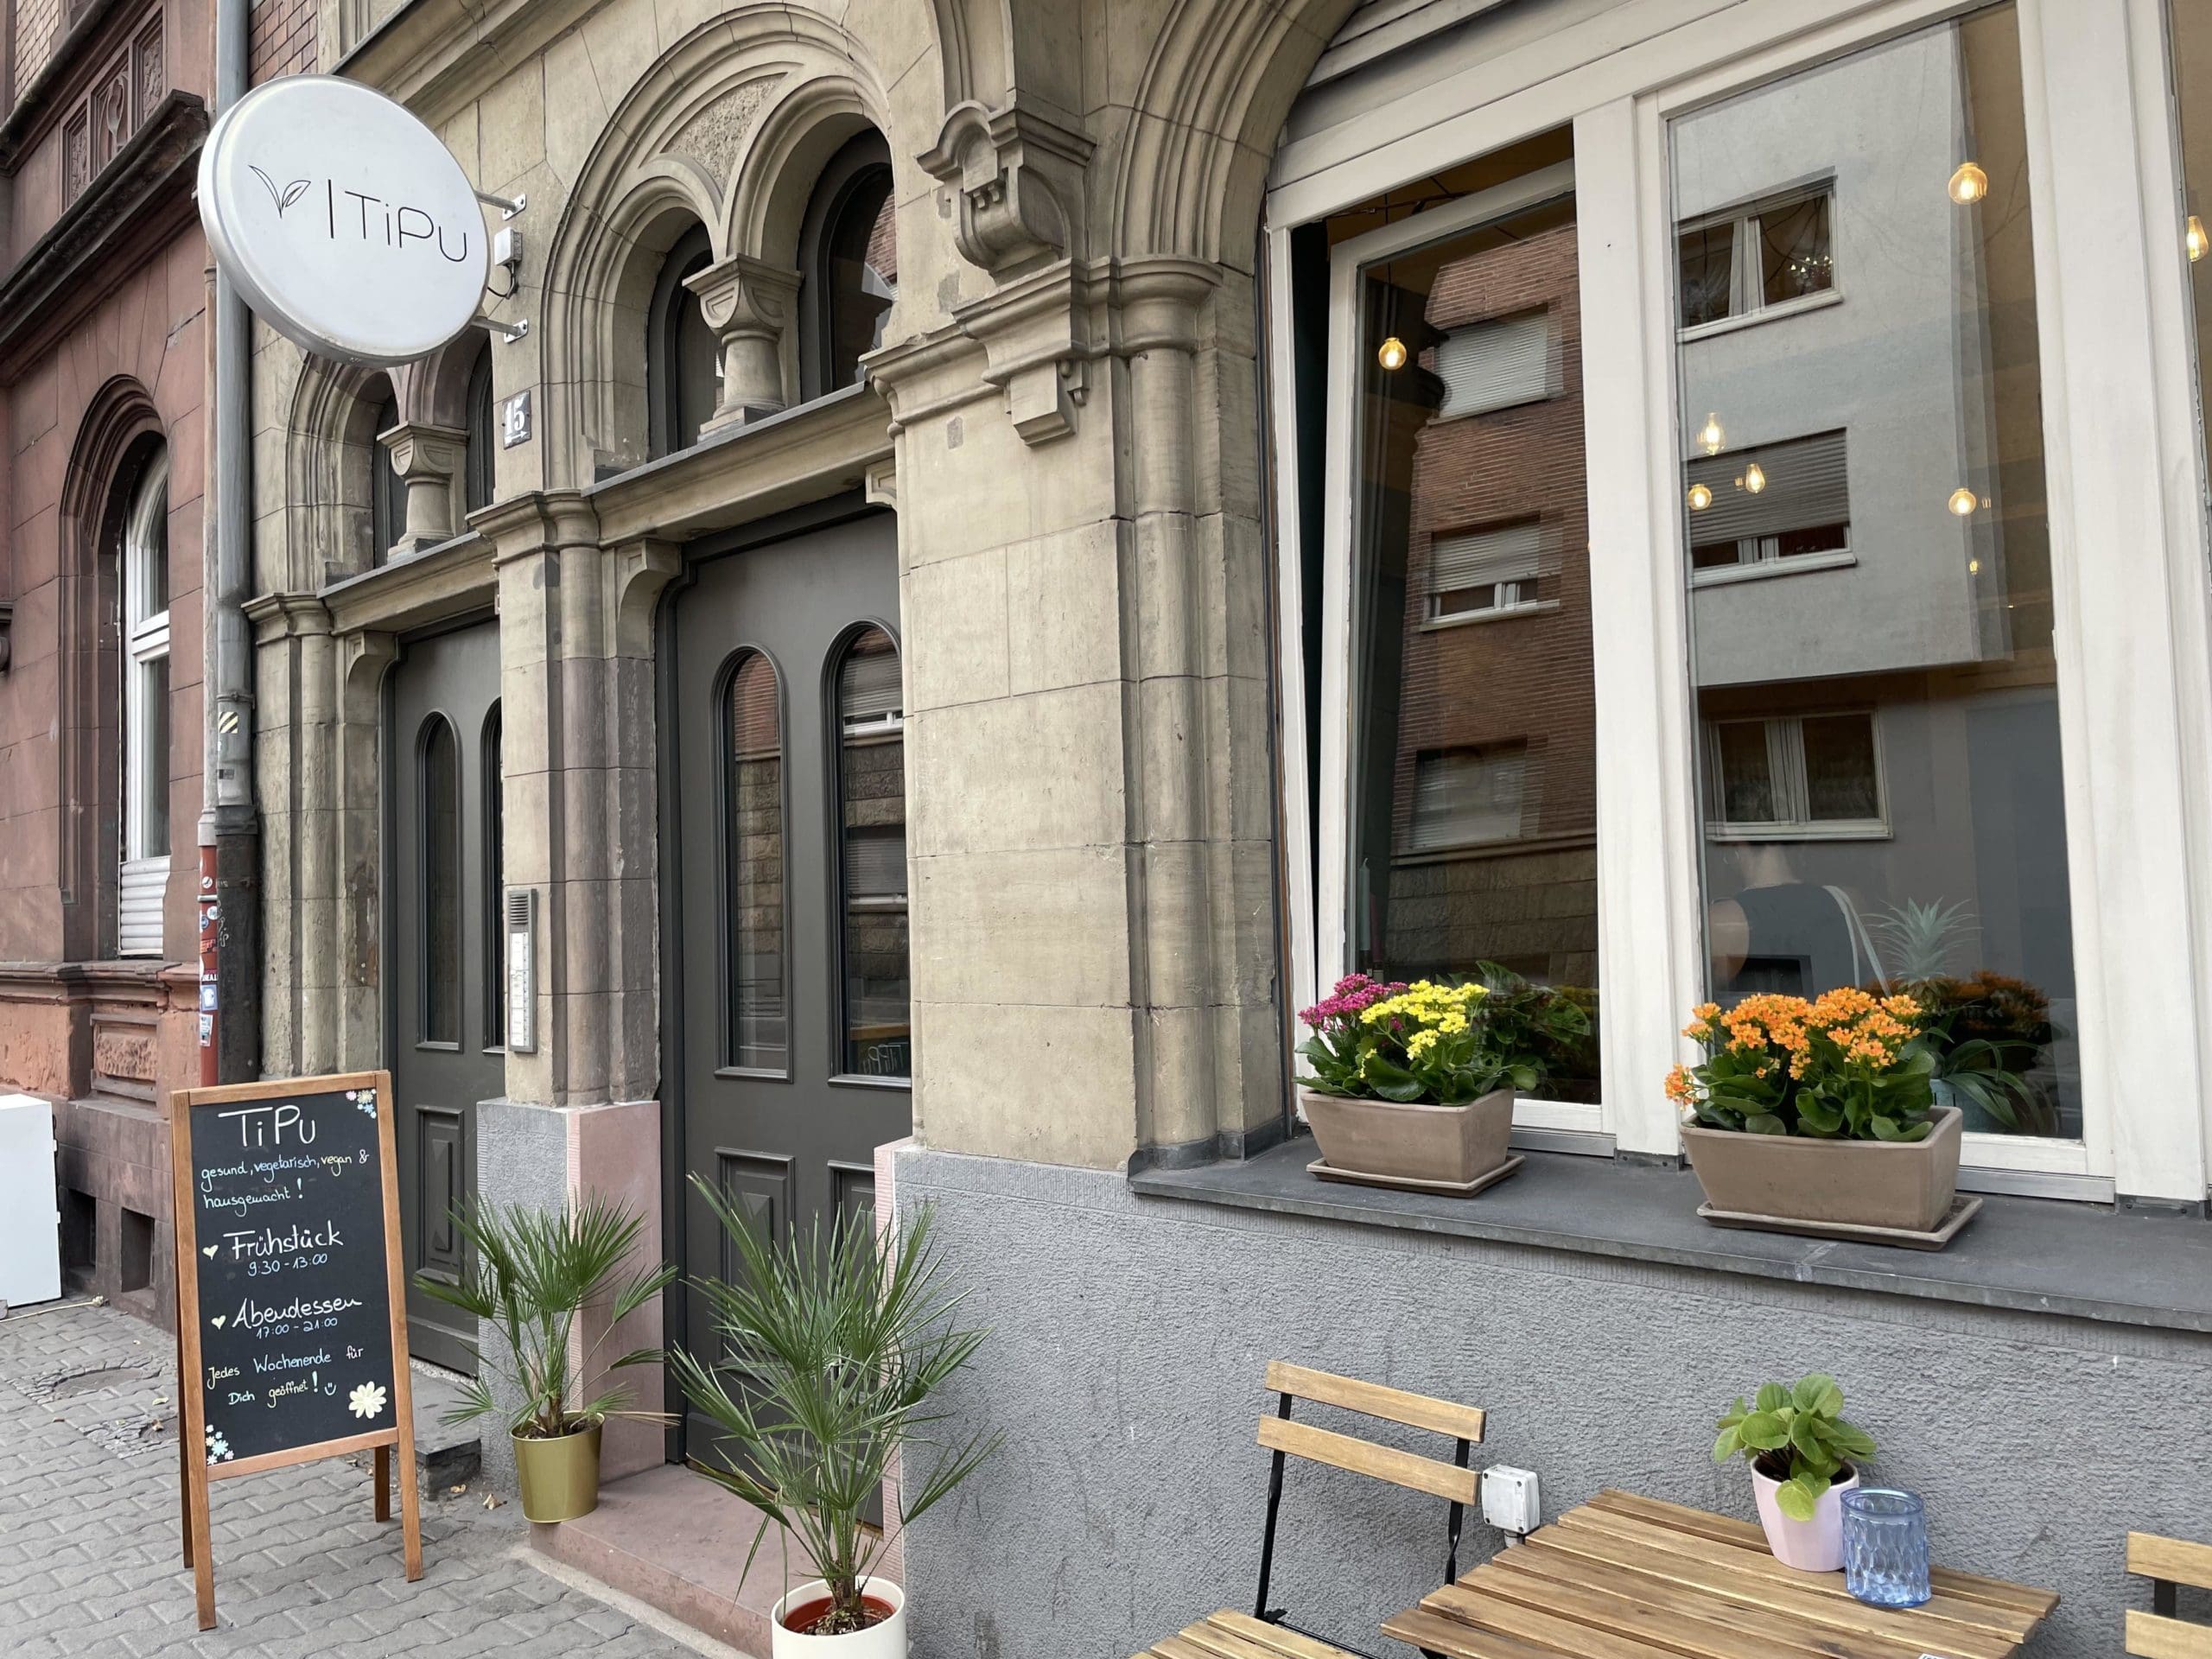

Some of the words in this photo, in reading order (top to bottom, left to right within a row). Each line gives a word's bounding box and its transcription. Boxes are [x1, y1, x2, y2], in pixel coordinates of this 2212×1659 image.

[505, 397, 525, 435] 15
[321, 1155, 353, 1176] vegan
[359, 1148, 370, 1164] &
[223, 1219, 344, 1260] Frühstück
[232, 1297, 362, 1329] Abendessen
[207, 1366, 240, 1389] Jedes
[253, 1347, 332, 1374] Wochenende
[346, 1344, 364, 1360] für
[227, 1390, 256, 1406] Dich
